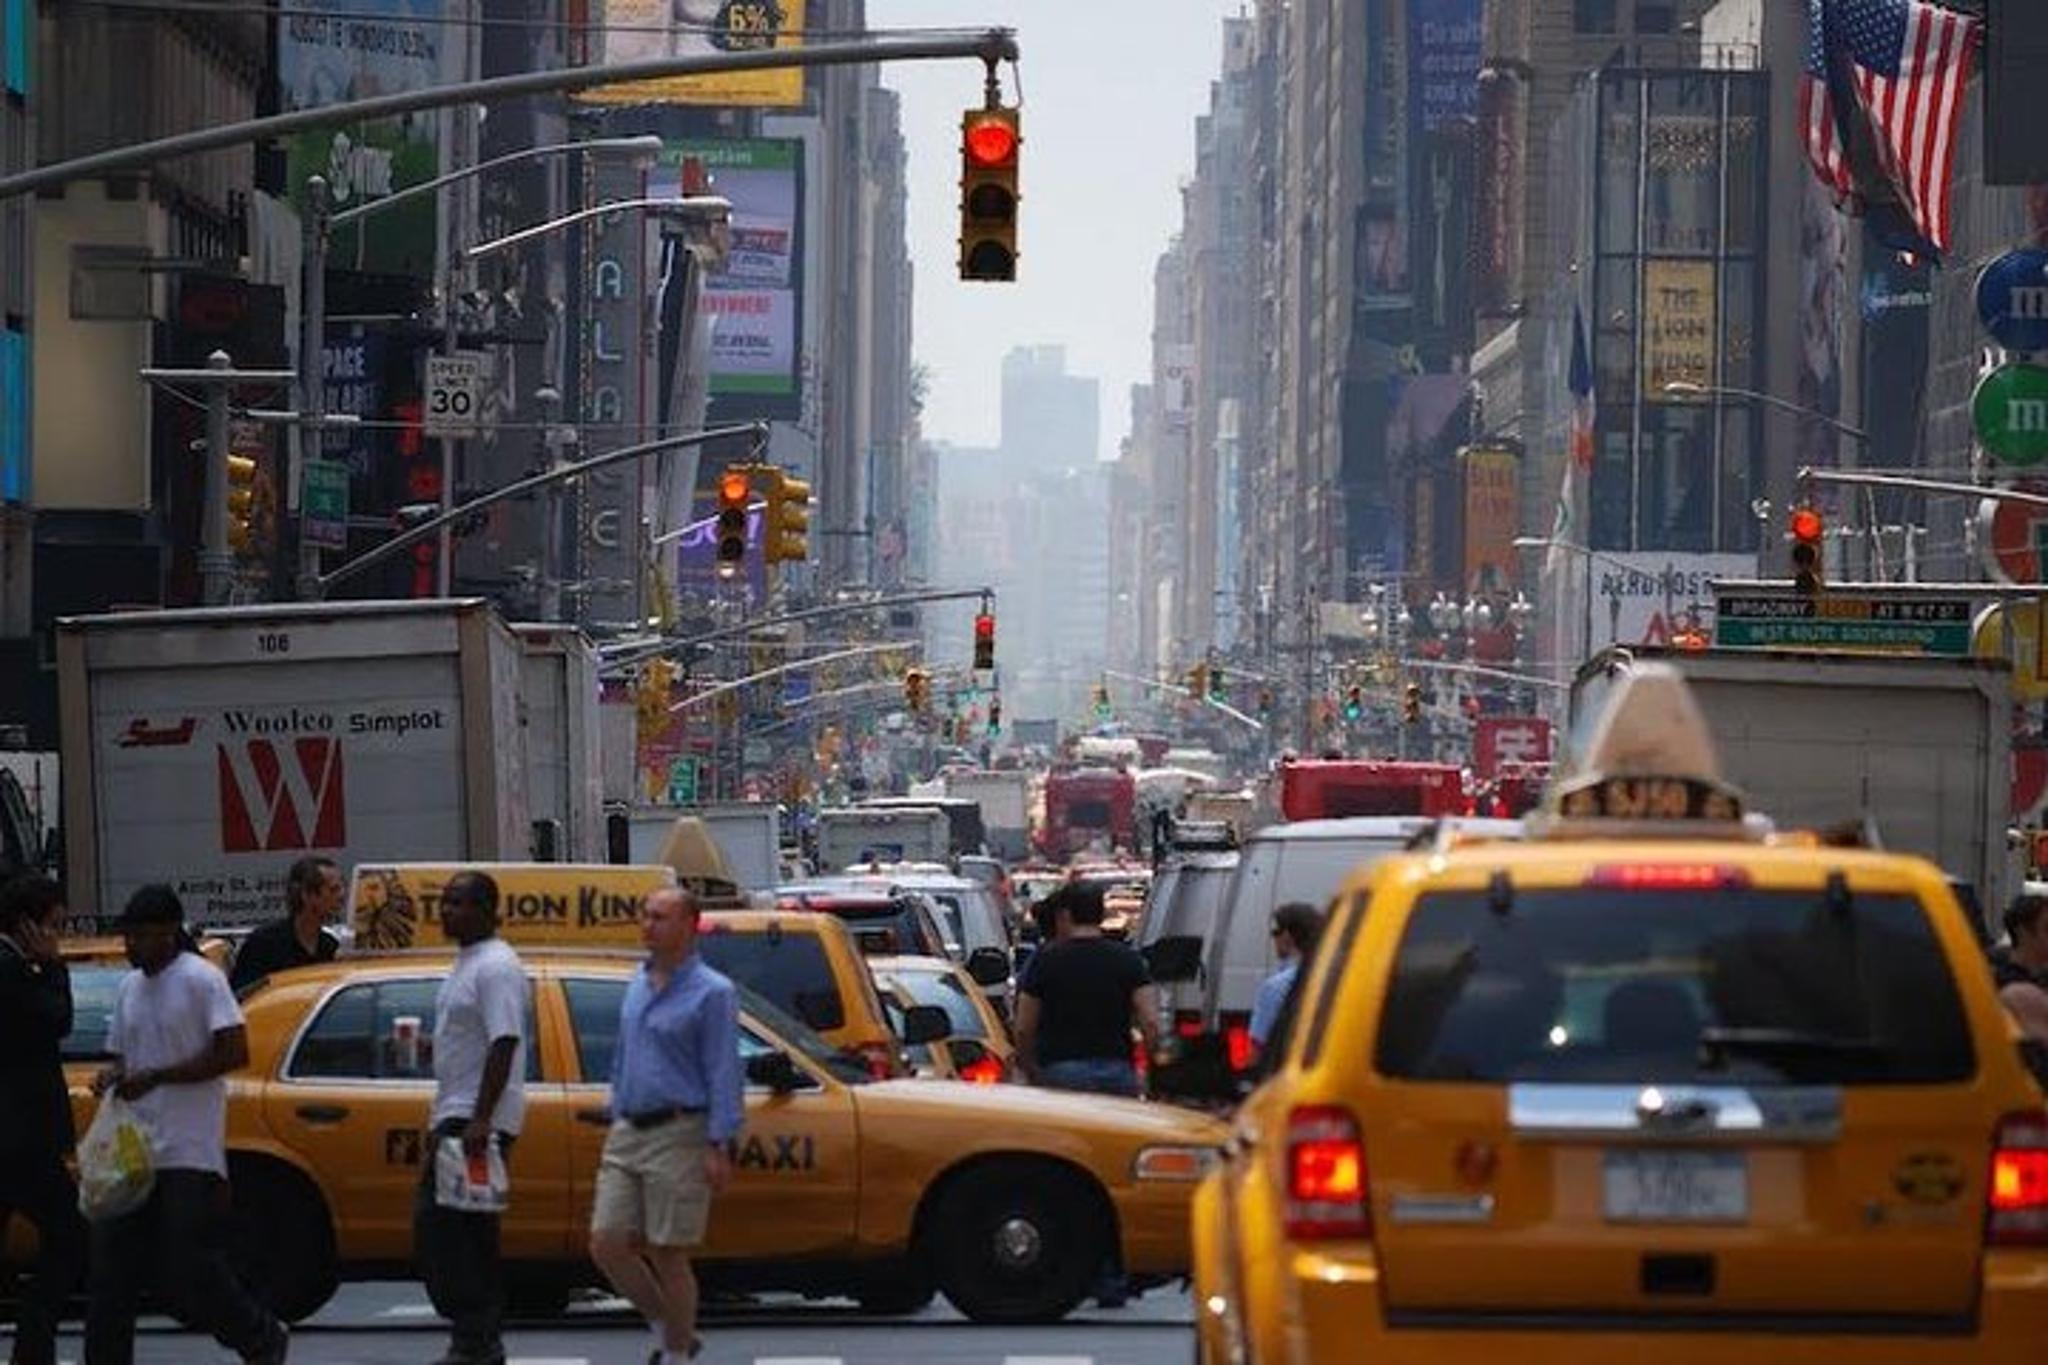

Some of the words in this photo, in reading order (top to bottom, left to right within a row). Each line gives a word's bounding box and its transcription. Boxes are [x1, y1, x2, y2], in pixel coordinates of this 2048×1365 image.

[730, 4, 769, 34] 6%
[2010, 286, 2048, 319] m
[431, 362, 476, 374] SPEED
[434, 377, 469, 387] LIMIT
[432, 388, 471, 415] 30
[2008, 400, 2047, 431] m
[257, 634, 289, 652] 106
[222, 708, 333, 733] Woolco
[349, 708, 443, 736] Simplot
[503, 894, 568, 925] ION
